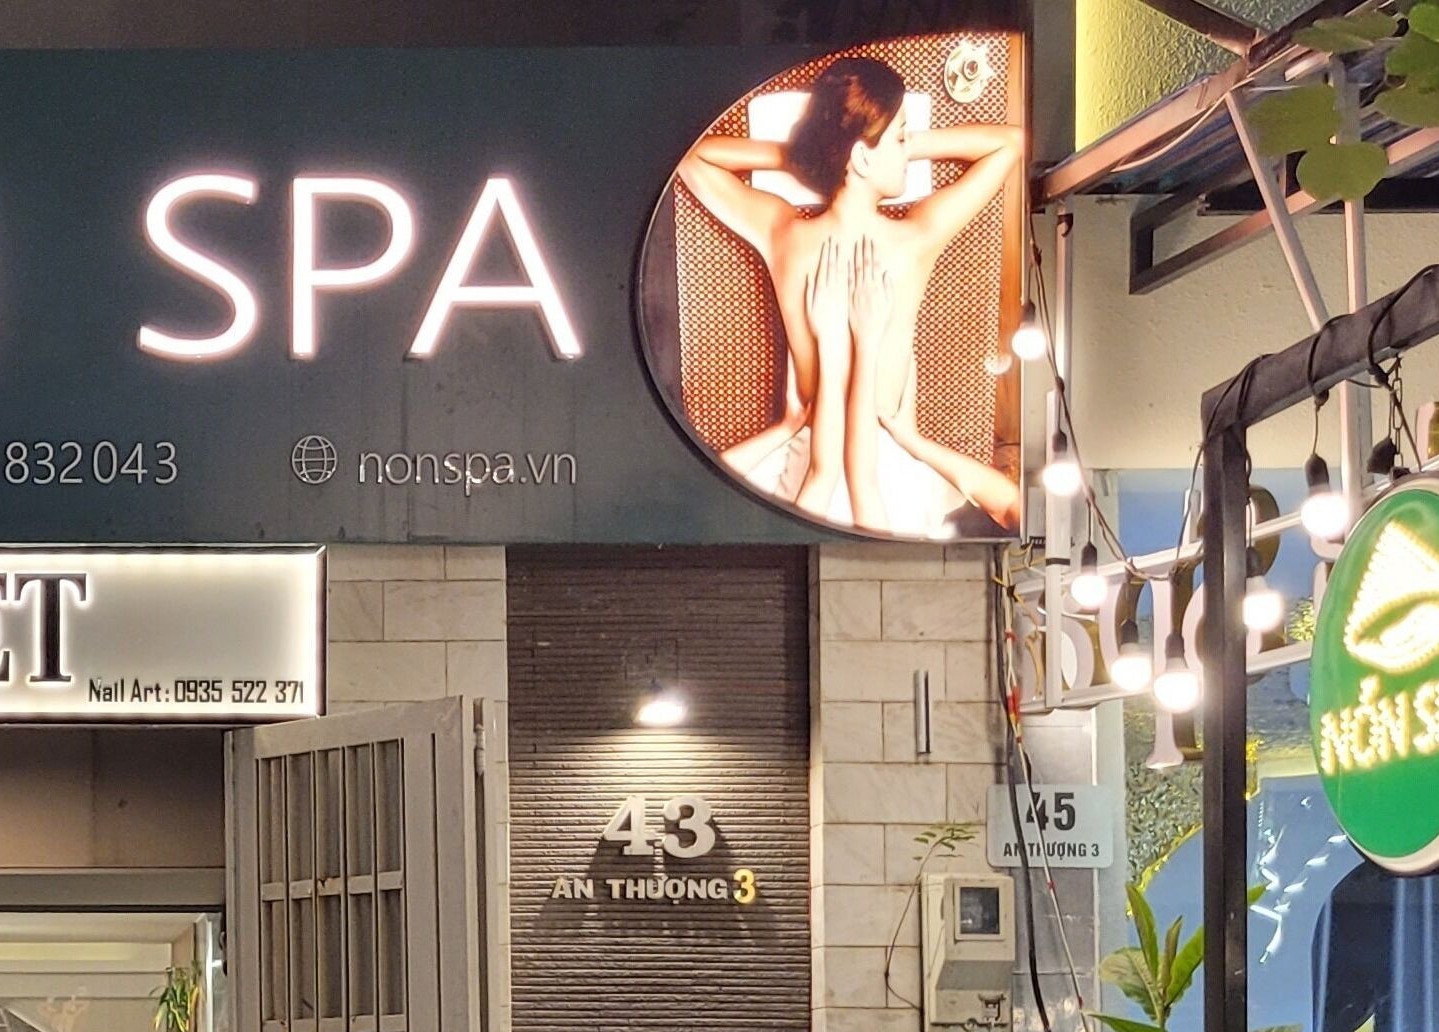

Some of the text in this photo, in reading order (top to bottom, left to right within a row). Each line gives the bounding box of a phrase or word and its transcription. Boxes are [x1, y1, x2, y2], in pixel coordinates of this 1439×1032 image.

[136, 172, 585, 361] SPA
[359, 448, 576, 496] nonspa.vn
[89, 678, 125, 702] Nail
[174, 679, 223, 703] 0935
[231, 679, 267, 703] 522
[275, 680, 304, 703] 371
[602, 794, 716, 859] 43
[1025, 791, 1076, 832] 45
[1090, 842, 1100, 858] 3
[732, 868, 757, 905] 3
